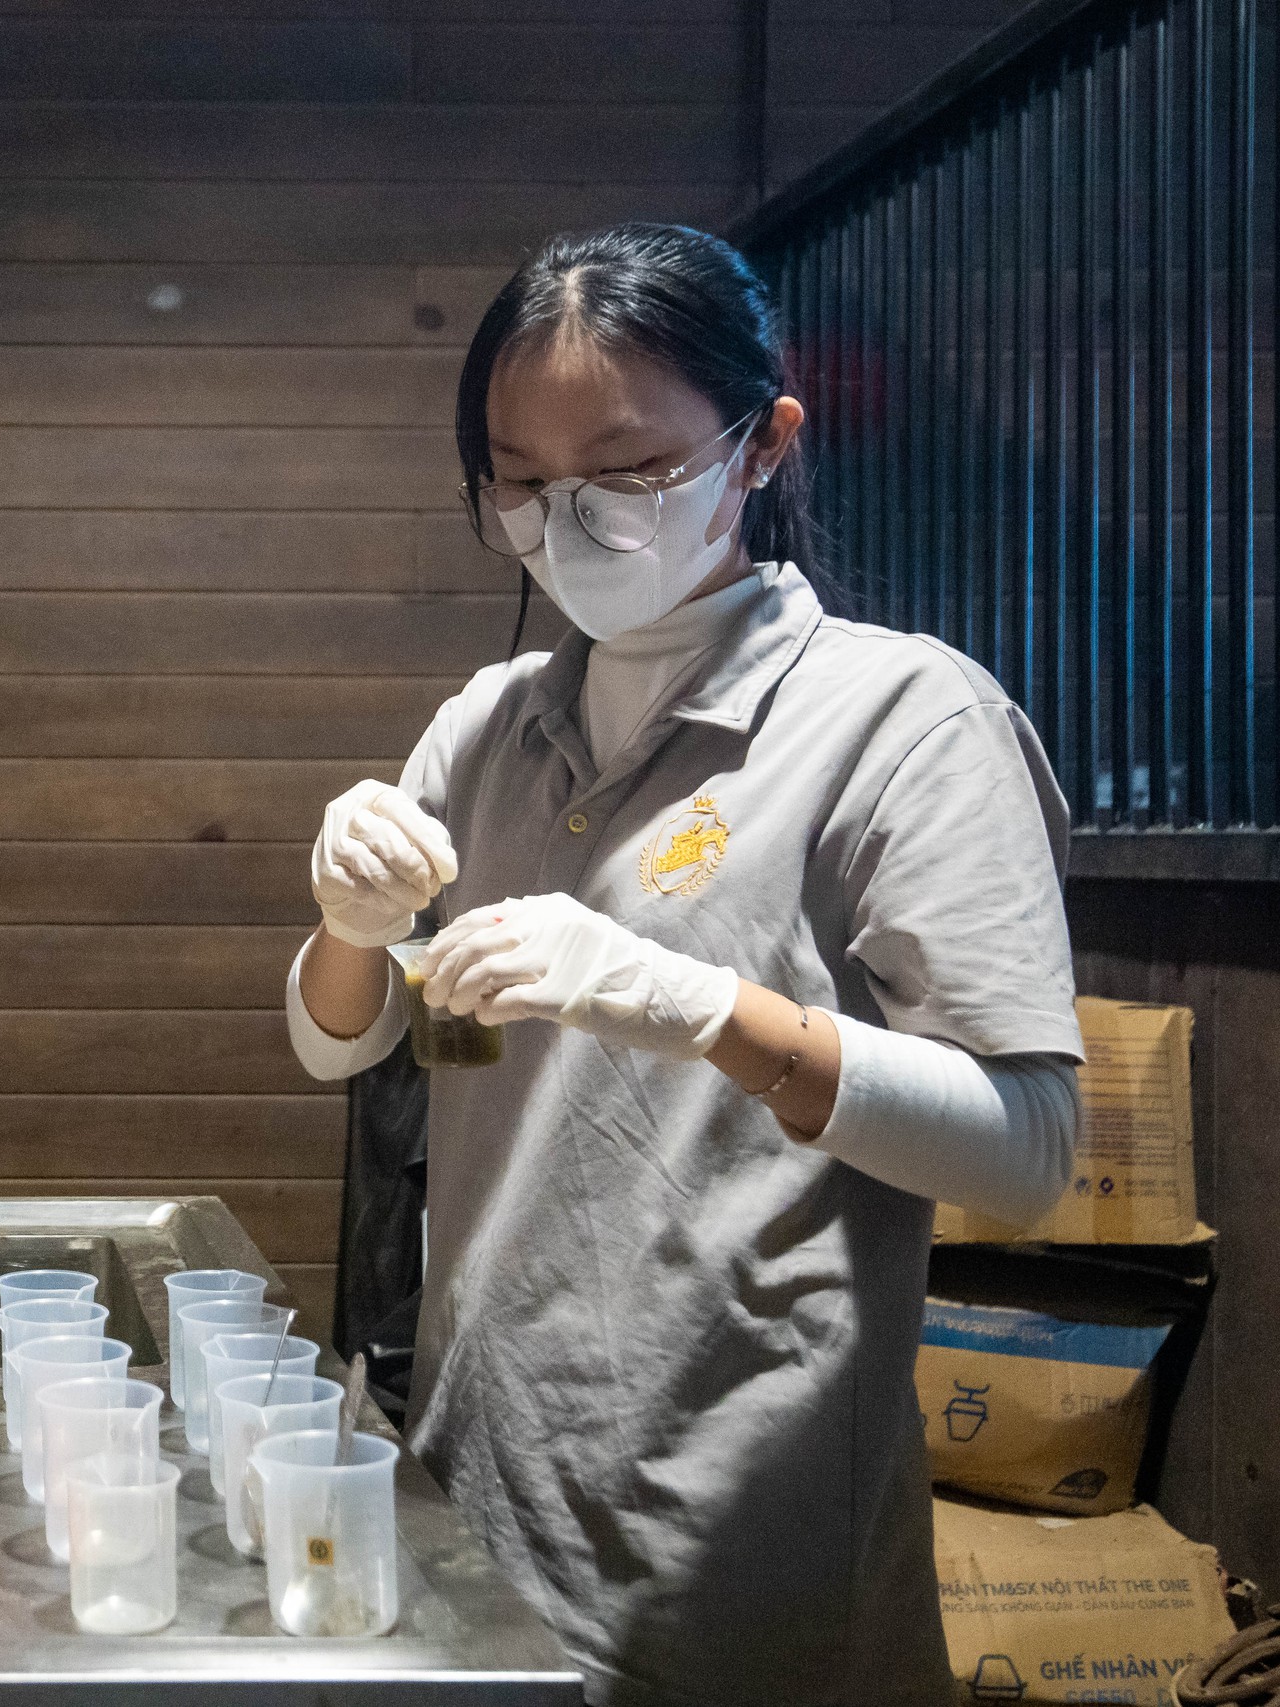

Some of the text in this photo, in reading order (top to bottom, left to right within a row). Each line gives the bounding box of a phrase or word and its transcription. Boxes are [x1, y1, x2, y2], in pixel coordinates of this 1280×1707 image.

[1120, 1578, 1156, 1594] THE
[1158, 1578, 1193, 1593] ONE
[1040, 1652, 1086, 1680] GHẾ
[1091, 1653, 1158, 1679] NHÂN
